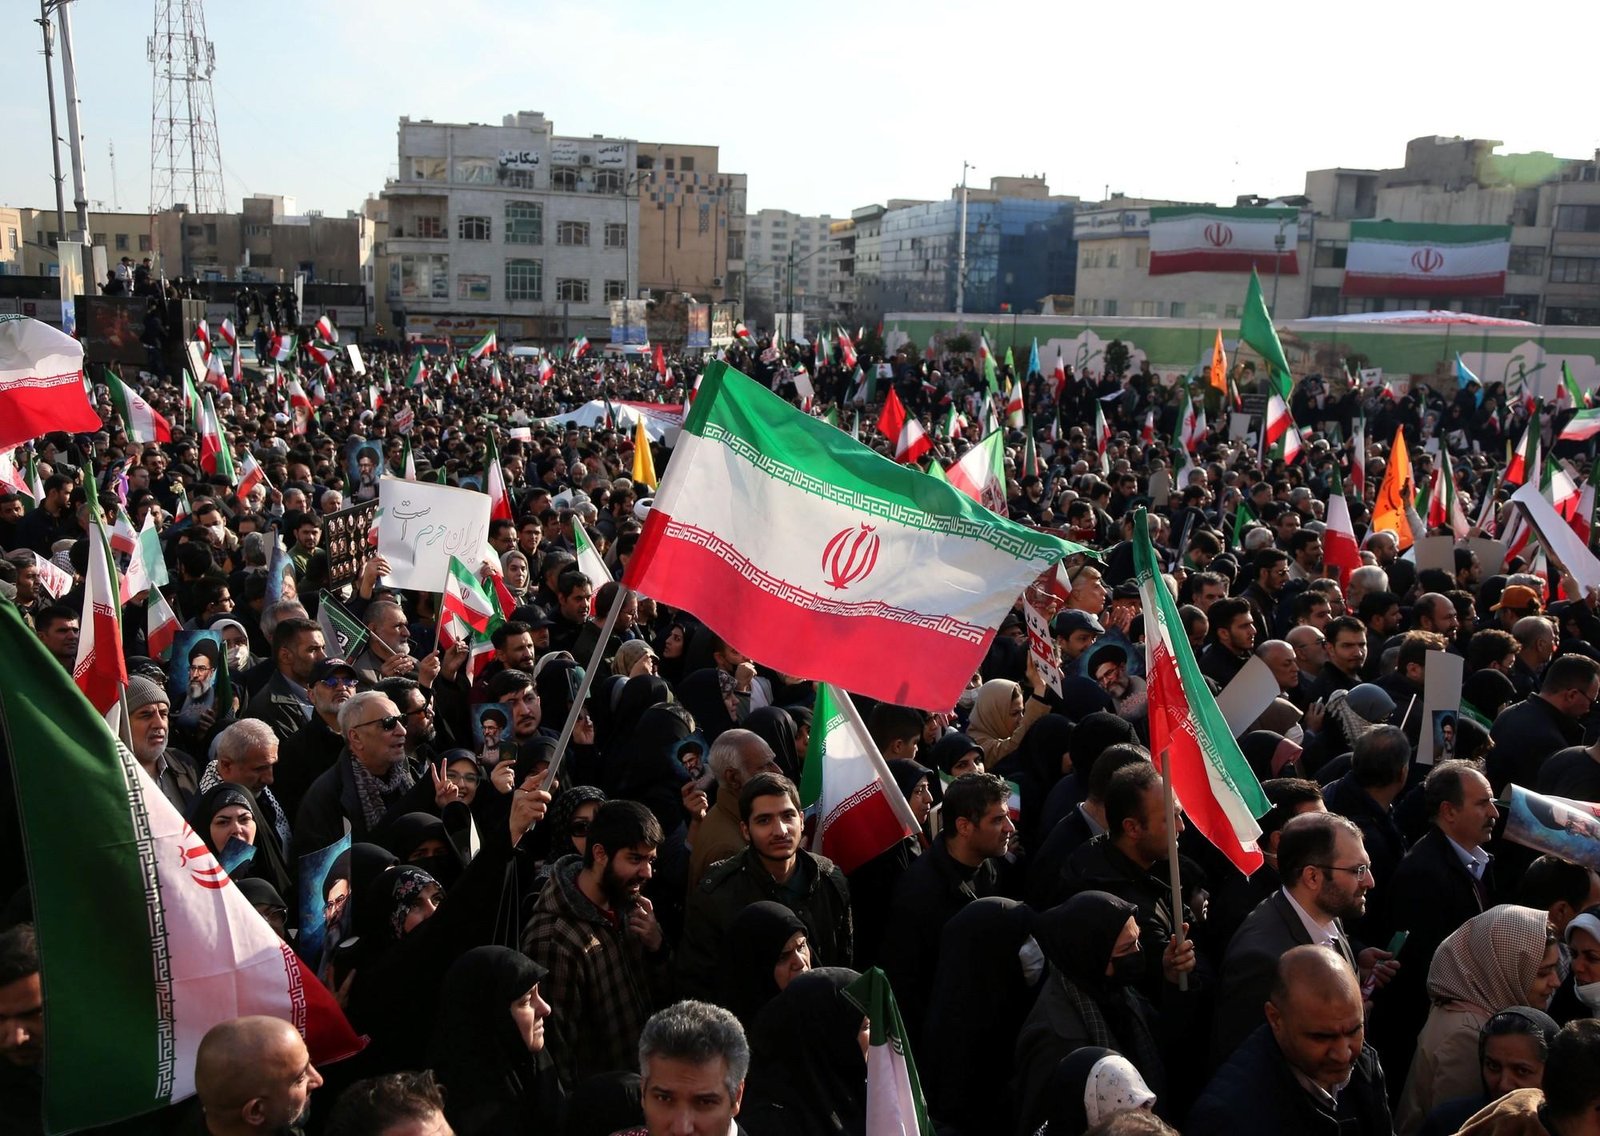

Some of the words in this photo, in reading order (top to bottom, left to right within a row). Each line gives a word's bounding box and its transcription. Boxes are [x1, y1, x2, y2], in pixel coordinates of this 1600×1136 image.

[499, 151, 539, 168] نیکایش
[598, 144, 624, 154] آکادمی
[392, 500, 432, 541] است
[412, 524, 448, 567] حرم
[442, 521, 485, 564] ایران
